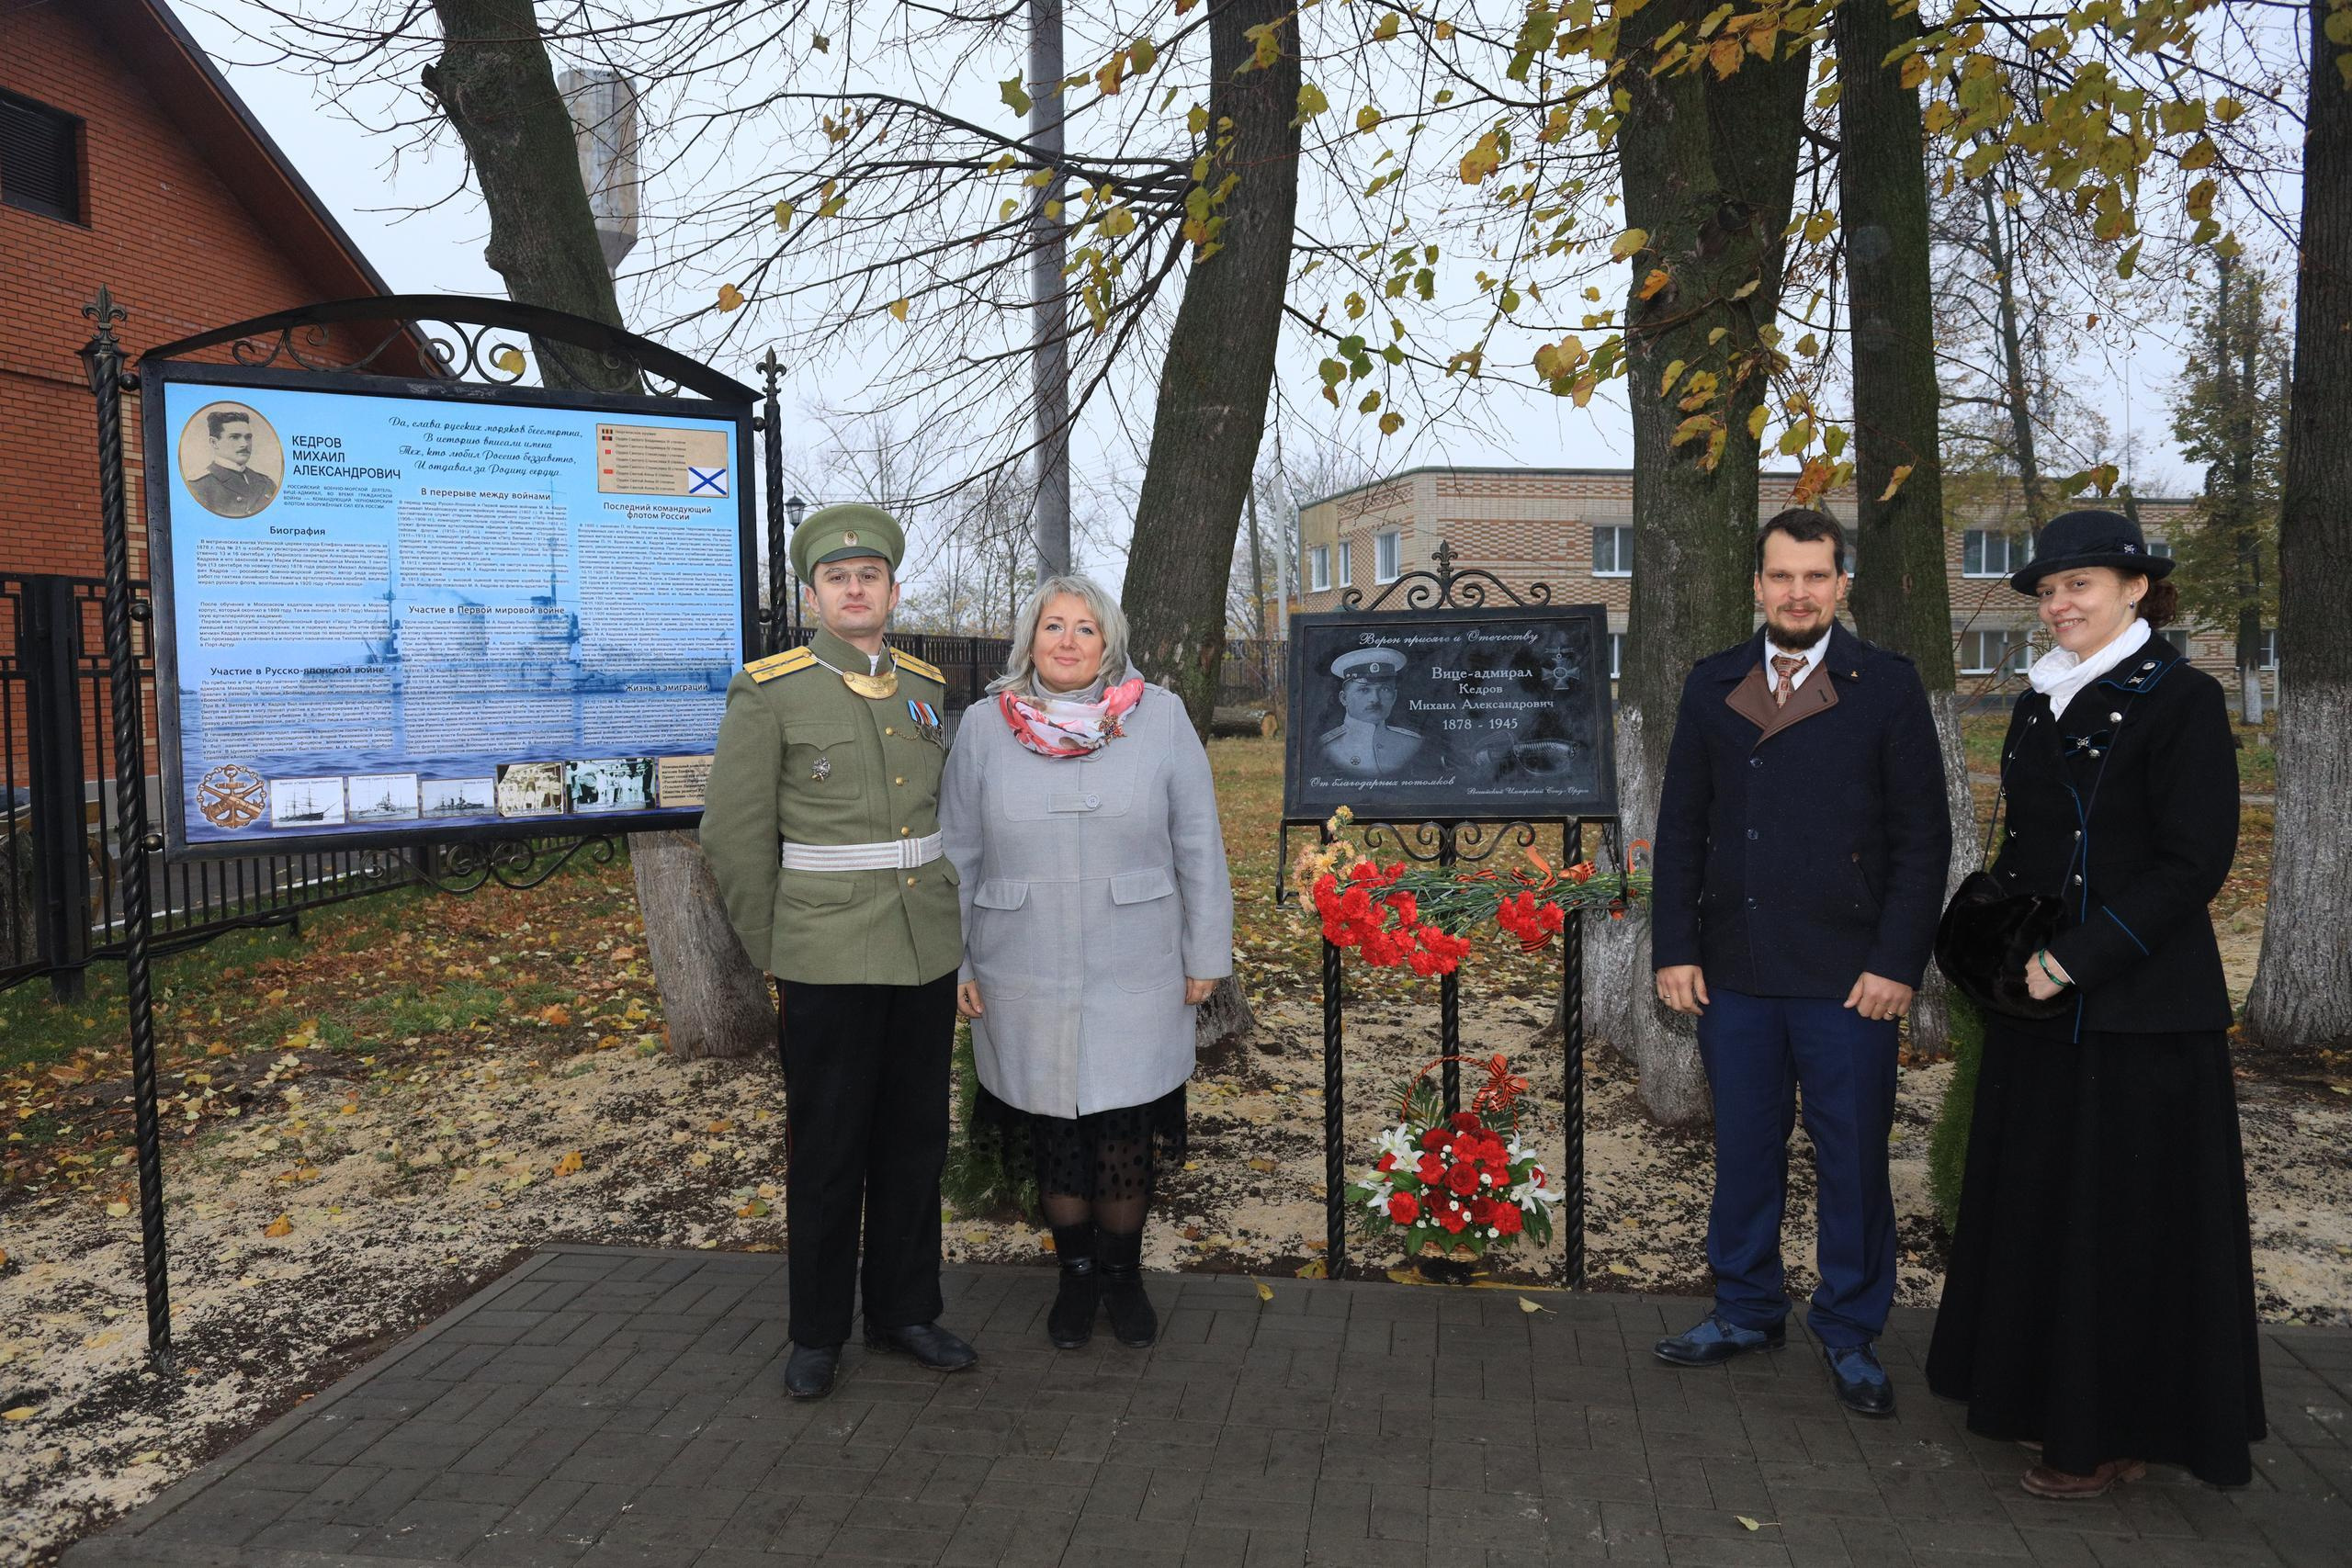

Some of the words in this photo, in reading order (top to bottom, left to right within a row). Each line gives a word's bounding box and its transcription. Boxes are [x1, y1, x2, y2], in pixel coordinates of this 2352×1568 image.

[389, 416, 410, 428] Да,
[412, 419, 442, 429] слава
[443, 422, 481, 432] русских
[484, 424, 526, 434] моряков
[527, 425, 583, 438] бессмертна,
[292, 435, 342, 448] КЕДРОВ
[424, 433, 434, 442] В
[435, 435, 481, 446] историю
[483, 437, 522, 447] вписали
[292, 450, 345, 463] МИХАИЛ
[399, 446, 424, 457] Тех,
[426, 447, 447, 457] кто
[448, 448, 481, 458] любил
[482, 450, 521, 461] Россию
[523, 453, 577, 464] беззаветно,
[293, 465, 401, 479] АЛЕКСАНДРОВИЧ
[414, 460, 426, 469] И
[428, 463, 472, 472] отдавал
[472, 465, 486, 474] за
[488, 463, 526, 476] Родину
[421, 488, 427, 496] В
[430, 490, 477, 500] перерыве
[479, 491, 509, 500] между
[512, 492, 551, 501] войнами
[603, 502, 651, 512] Последний
[652, 505, 712, 514] командующий
[627, 512, 659, 520] флотом
[269, 525, 326, 536] Биография
[458, 606, 492, 615] Первой
[494, 606, 536, 615] мировой
[1359, 632, 1401, 648] Верен
[1403, 636, 1451, 647] присяге
[1453, 635, 1462, 643] и
[1465, 629, 1540, 645] Отечеству
[210, 667, 252, 676] Участие
[266, 666, 352, 676] Русско-японской
[1431, 667, 1533, 681] Вице-адмирал
[626, 683, 653, 692] Жизнь
[663, 683, 708, 693] эмиграции
[1458, 683, 1503, 695] Кедров
[1408, 700, 1456, 710] Михаил
[1462, 699, 1555, 710] Александрович
[1442, 719, 1472, 730] 1878
[1489, 718, 1519, 729] 1945
[1309, 776, 1329, 787] От
[1331, 777, 1398, 790] благодарных
[1401, 775, 1456, 786] потомков
